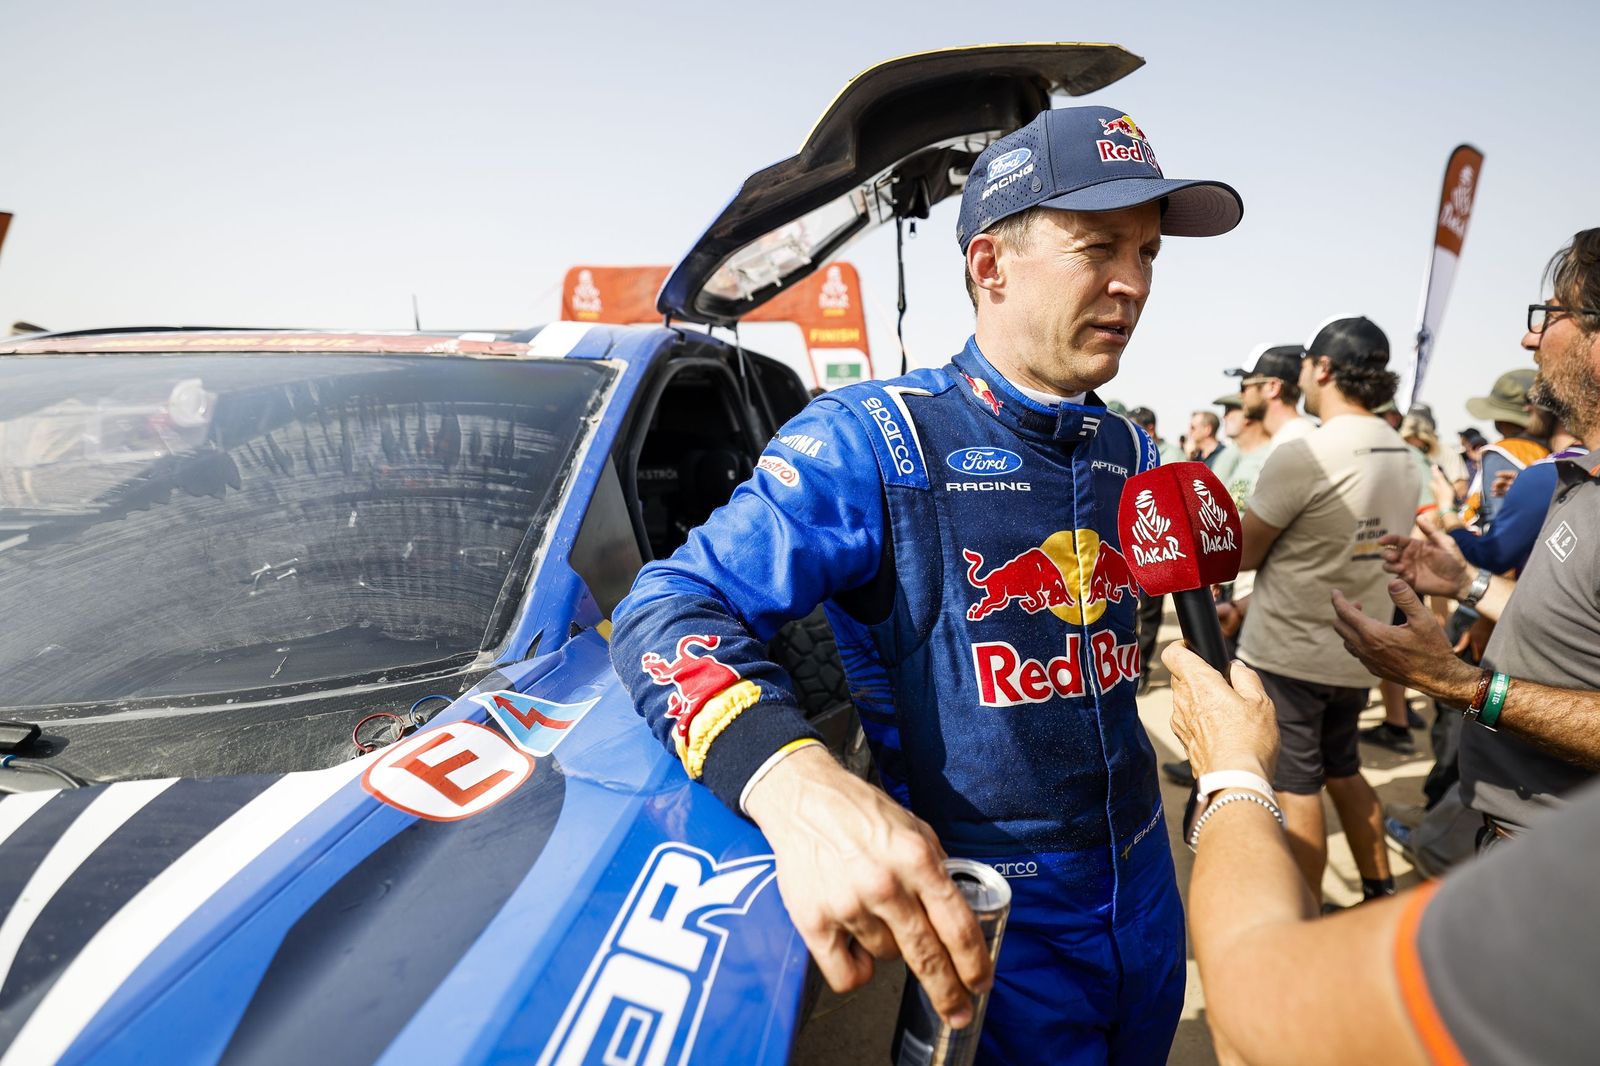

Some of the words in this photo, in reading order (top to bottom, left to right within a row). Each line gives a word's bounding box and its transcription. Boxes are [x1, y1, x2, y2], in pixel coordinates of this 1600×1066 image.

[1096, 139, 1145, 163] Red
[982, 163, 1034, 200] RACING
[810, 328, 860, 342] FINISH
[861, 397, 915, 476] sparco
[1091, 461, 1128, 479] APTOR
[946, 482, 1031, 491] RACING
[1132, 536, 1186, 567] DAKAR
[1200, 527, 1237, 554] DAKAR
[971, 633, 1086, 707] Red
[1090, 629, 1141, 695] Bul
[994, 861, 1038, 878] arco
